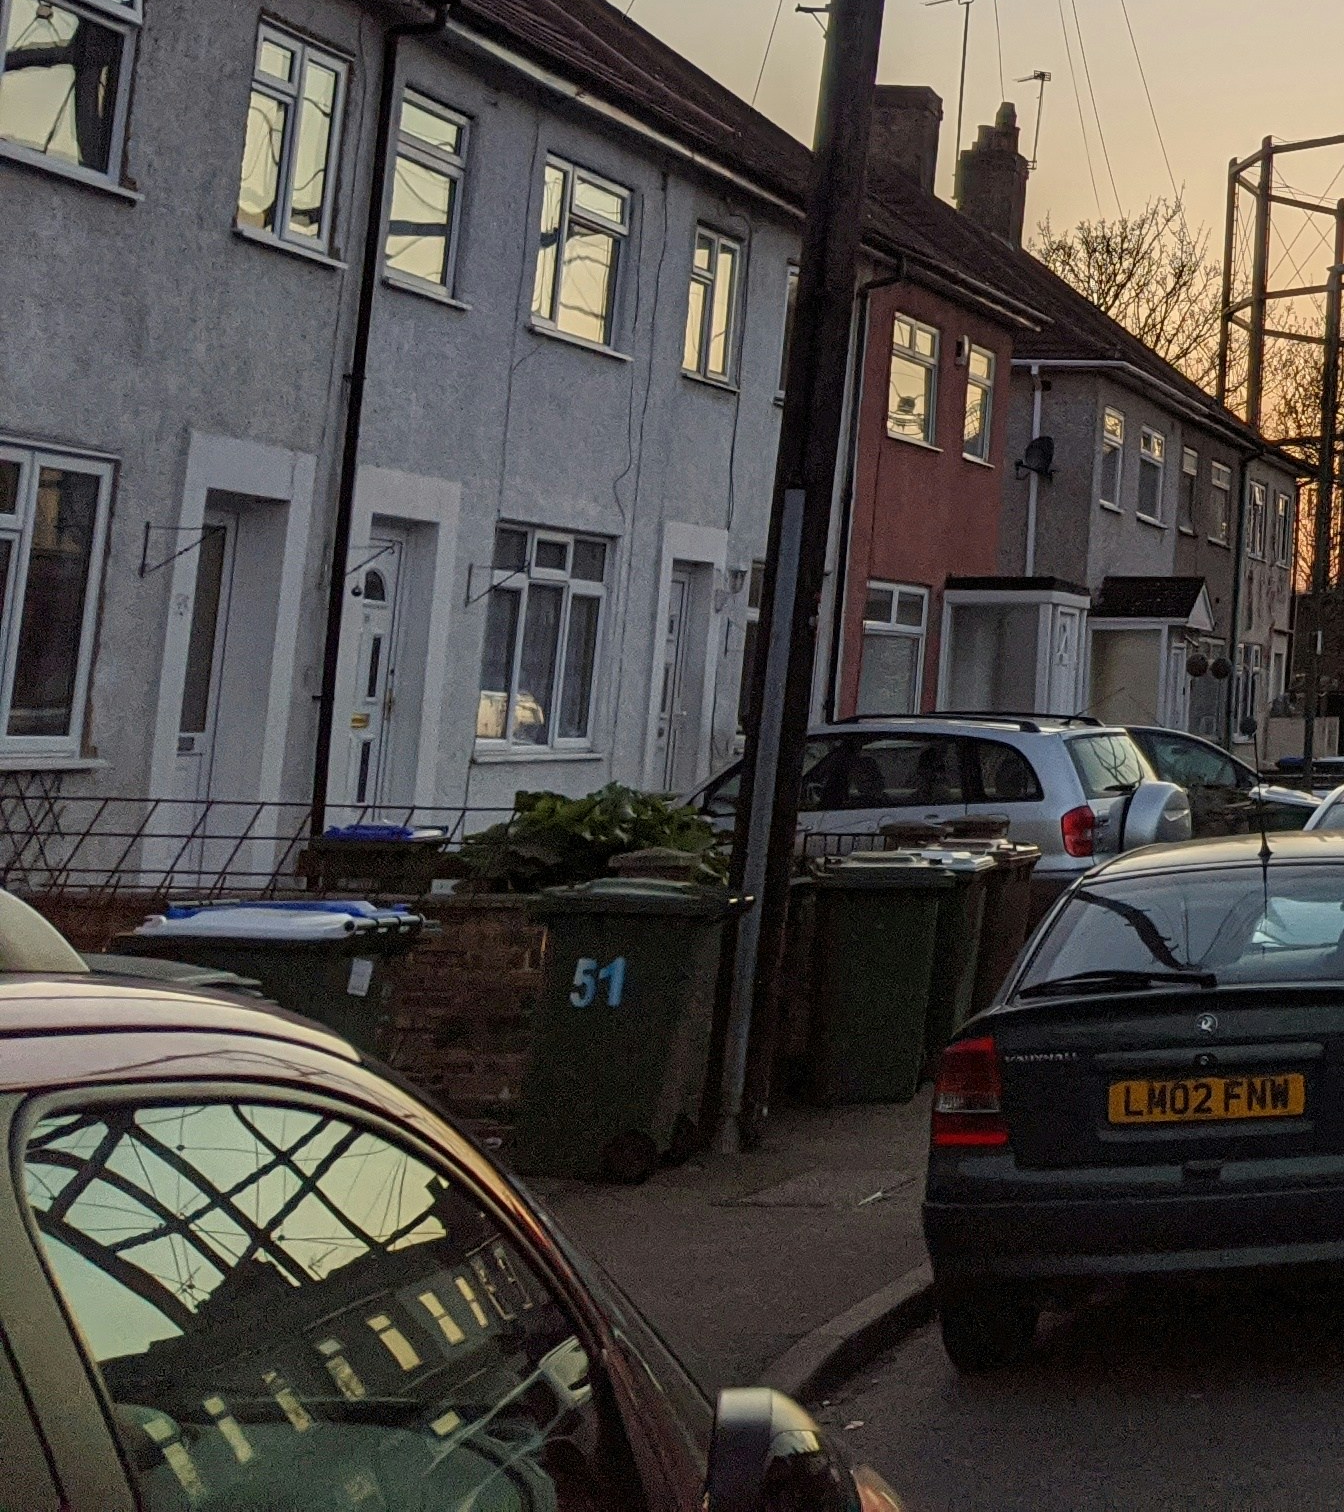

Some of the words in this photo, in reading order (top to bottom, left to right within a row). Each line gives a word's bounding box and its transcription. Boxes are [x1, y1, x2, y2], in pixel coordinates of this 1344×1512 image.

[569, 955, 625, 1007] 51
[1122, 1081, 1213, 1117] LM02
[1222, 1074, 1290, 1114] FNW
